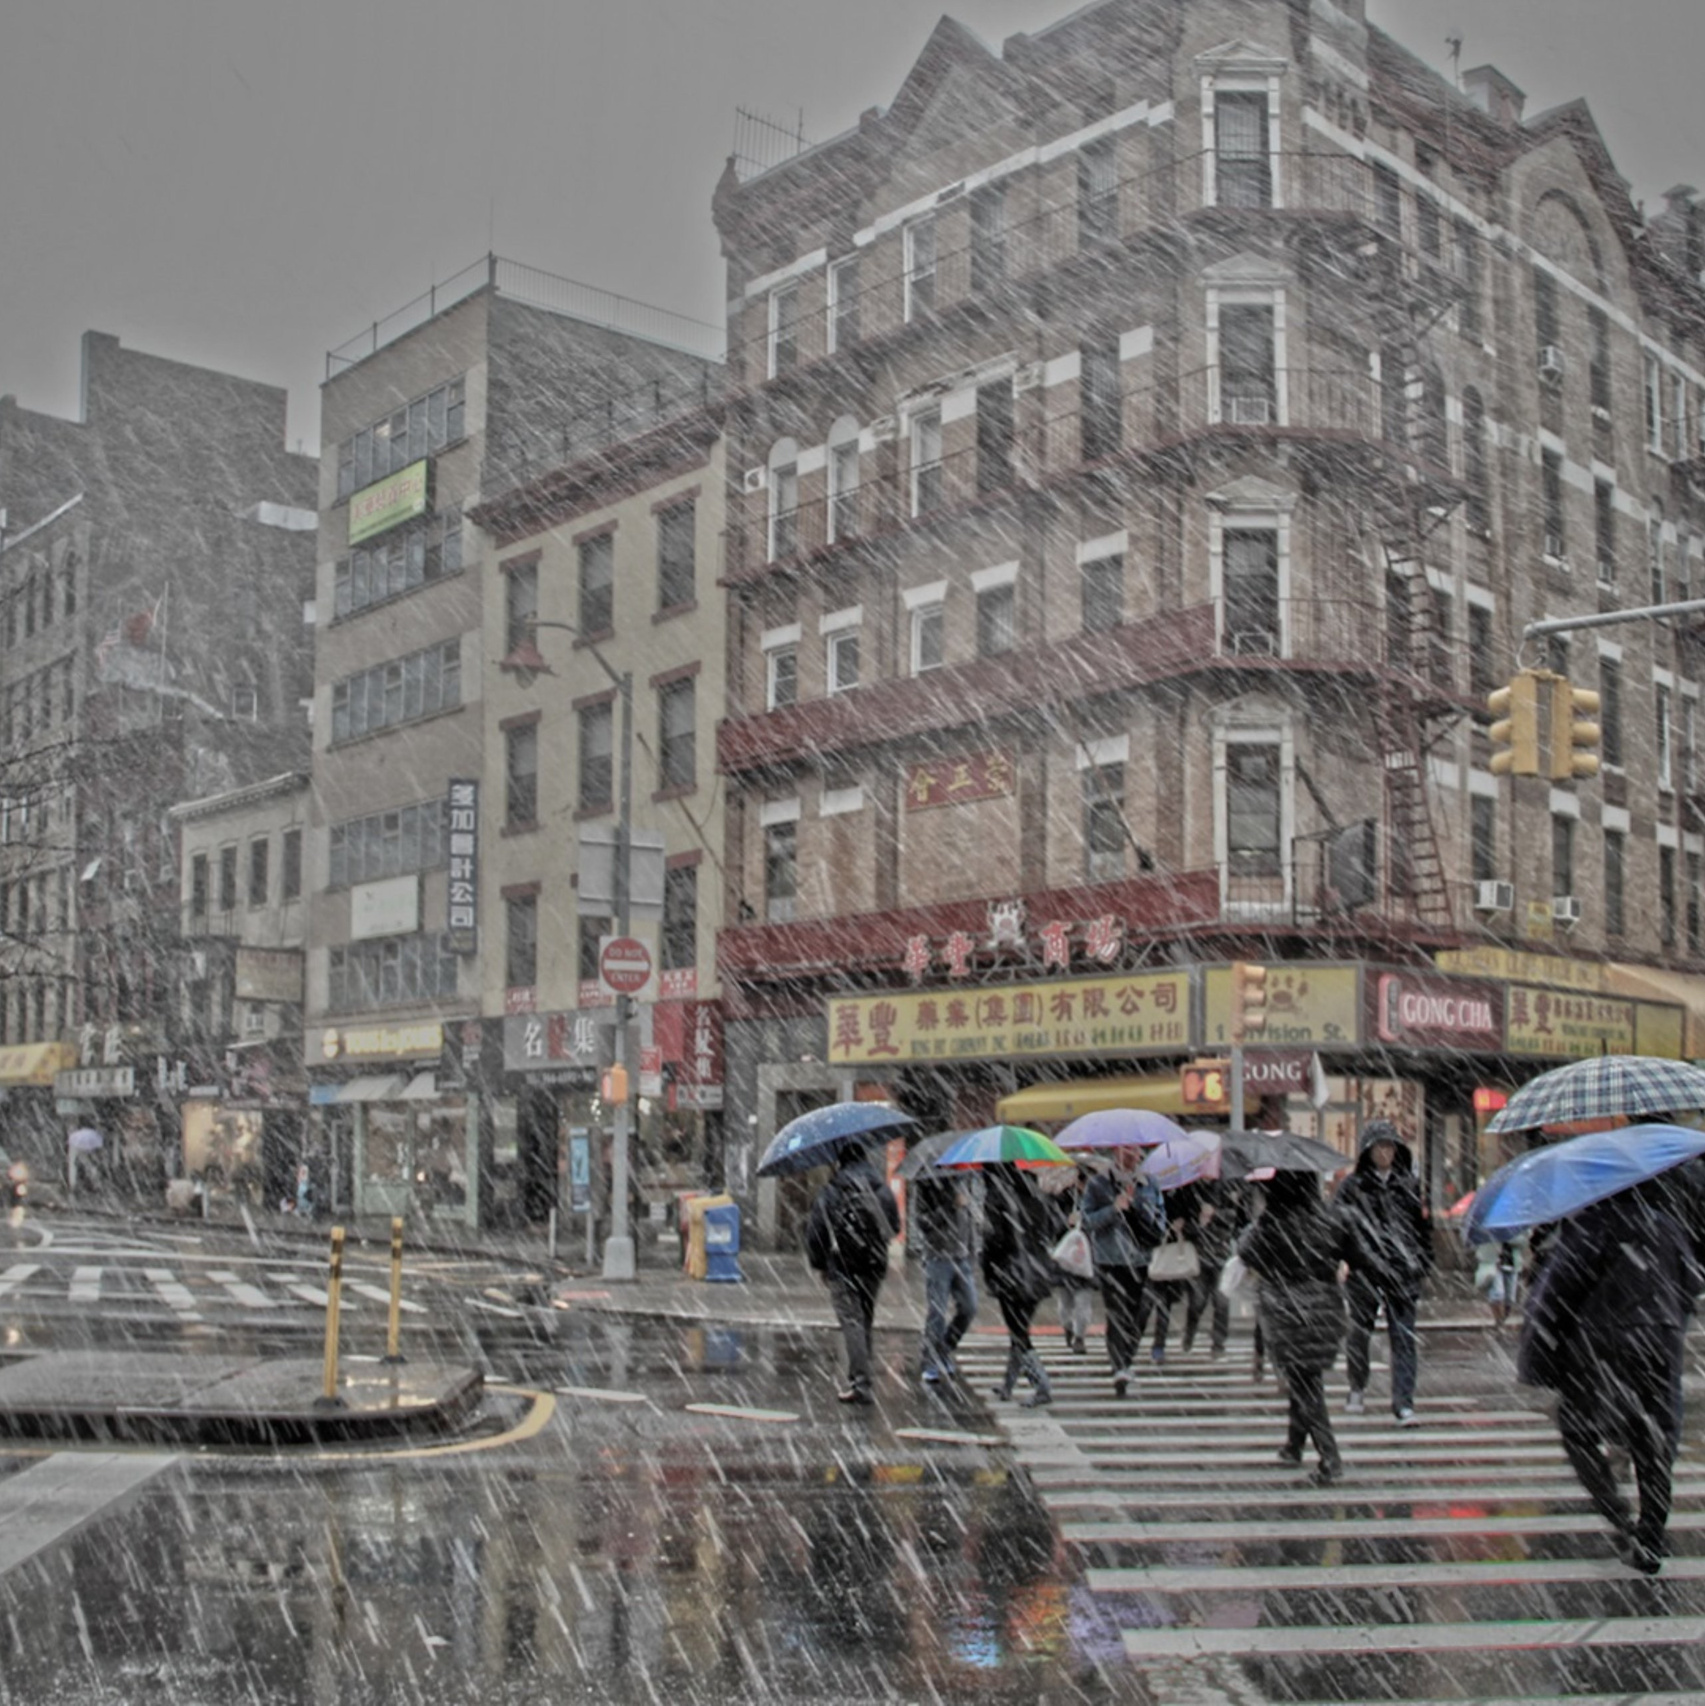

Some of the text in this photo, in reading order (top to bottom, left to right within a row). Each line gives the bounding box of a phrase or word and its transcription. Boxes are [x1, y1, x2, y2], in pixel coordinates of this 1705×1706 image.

[609, 947, 642, 958] DO NOT
[611, 972, 641, 982] ENTER
[1403, 993, 1455, 1026] GONG
[1458, 998, 1493, 1030] CHA
[1242, 1022, 1312, 1041] ivision
[1323, 1022, 1347, 1041] St.
[1205, 1071, 1222, 1101] 6
